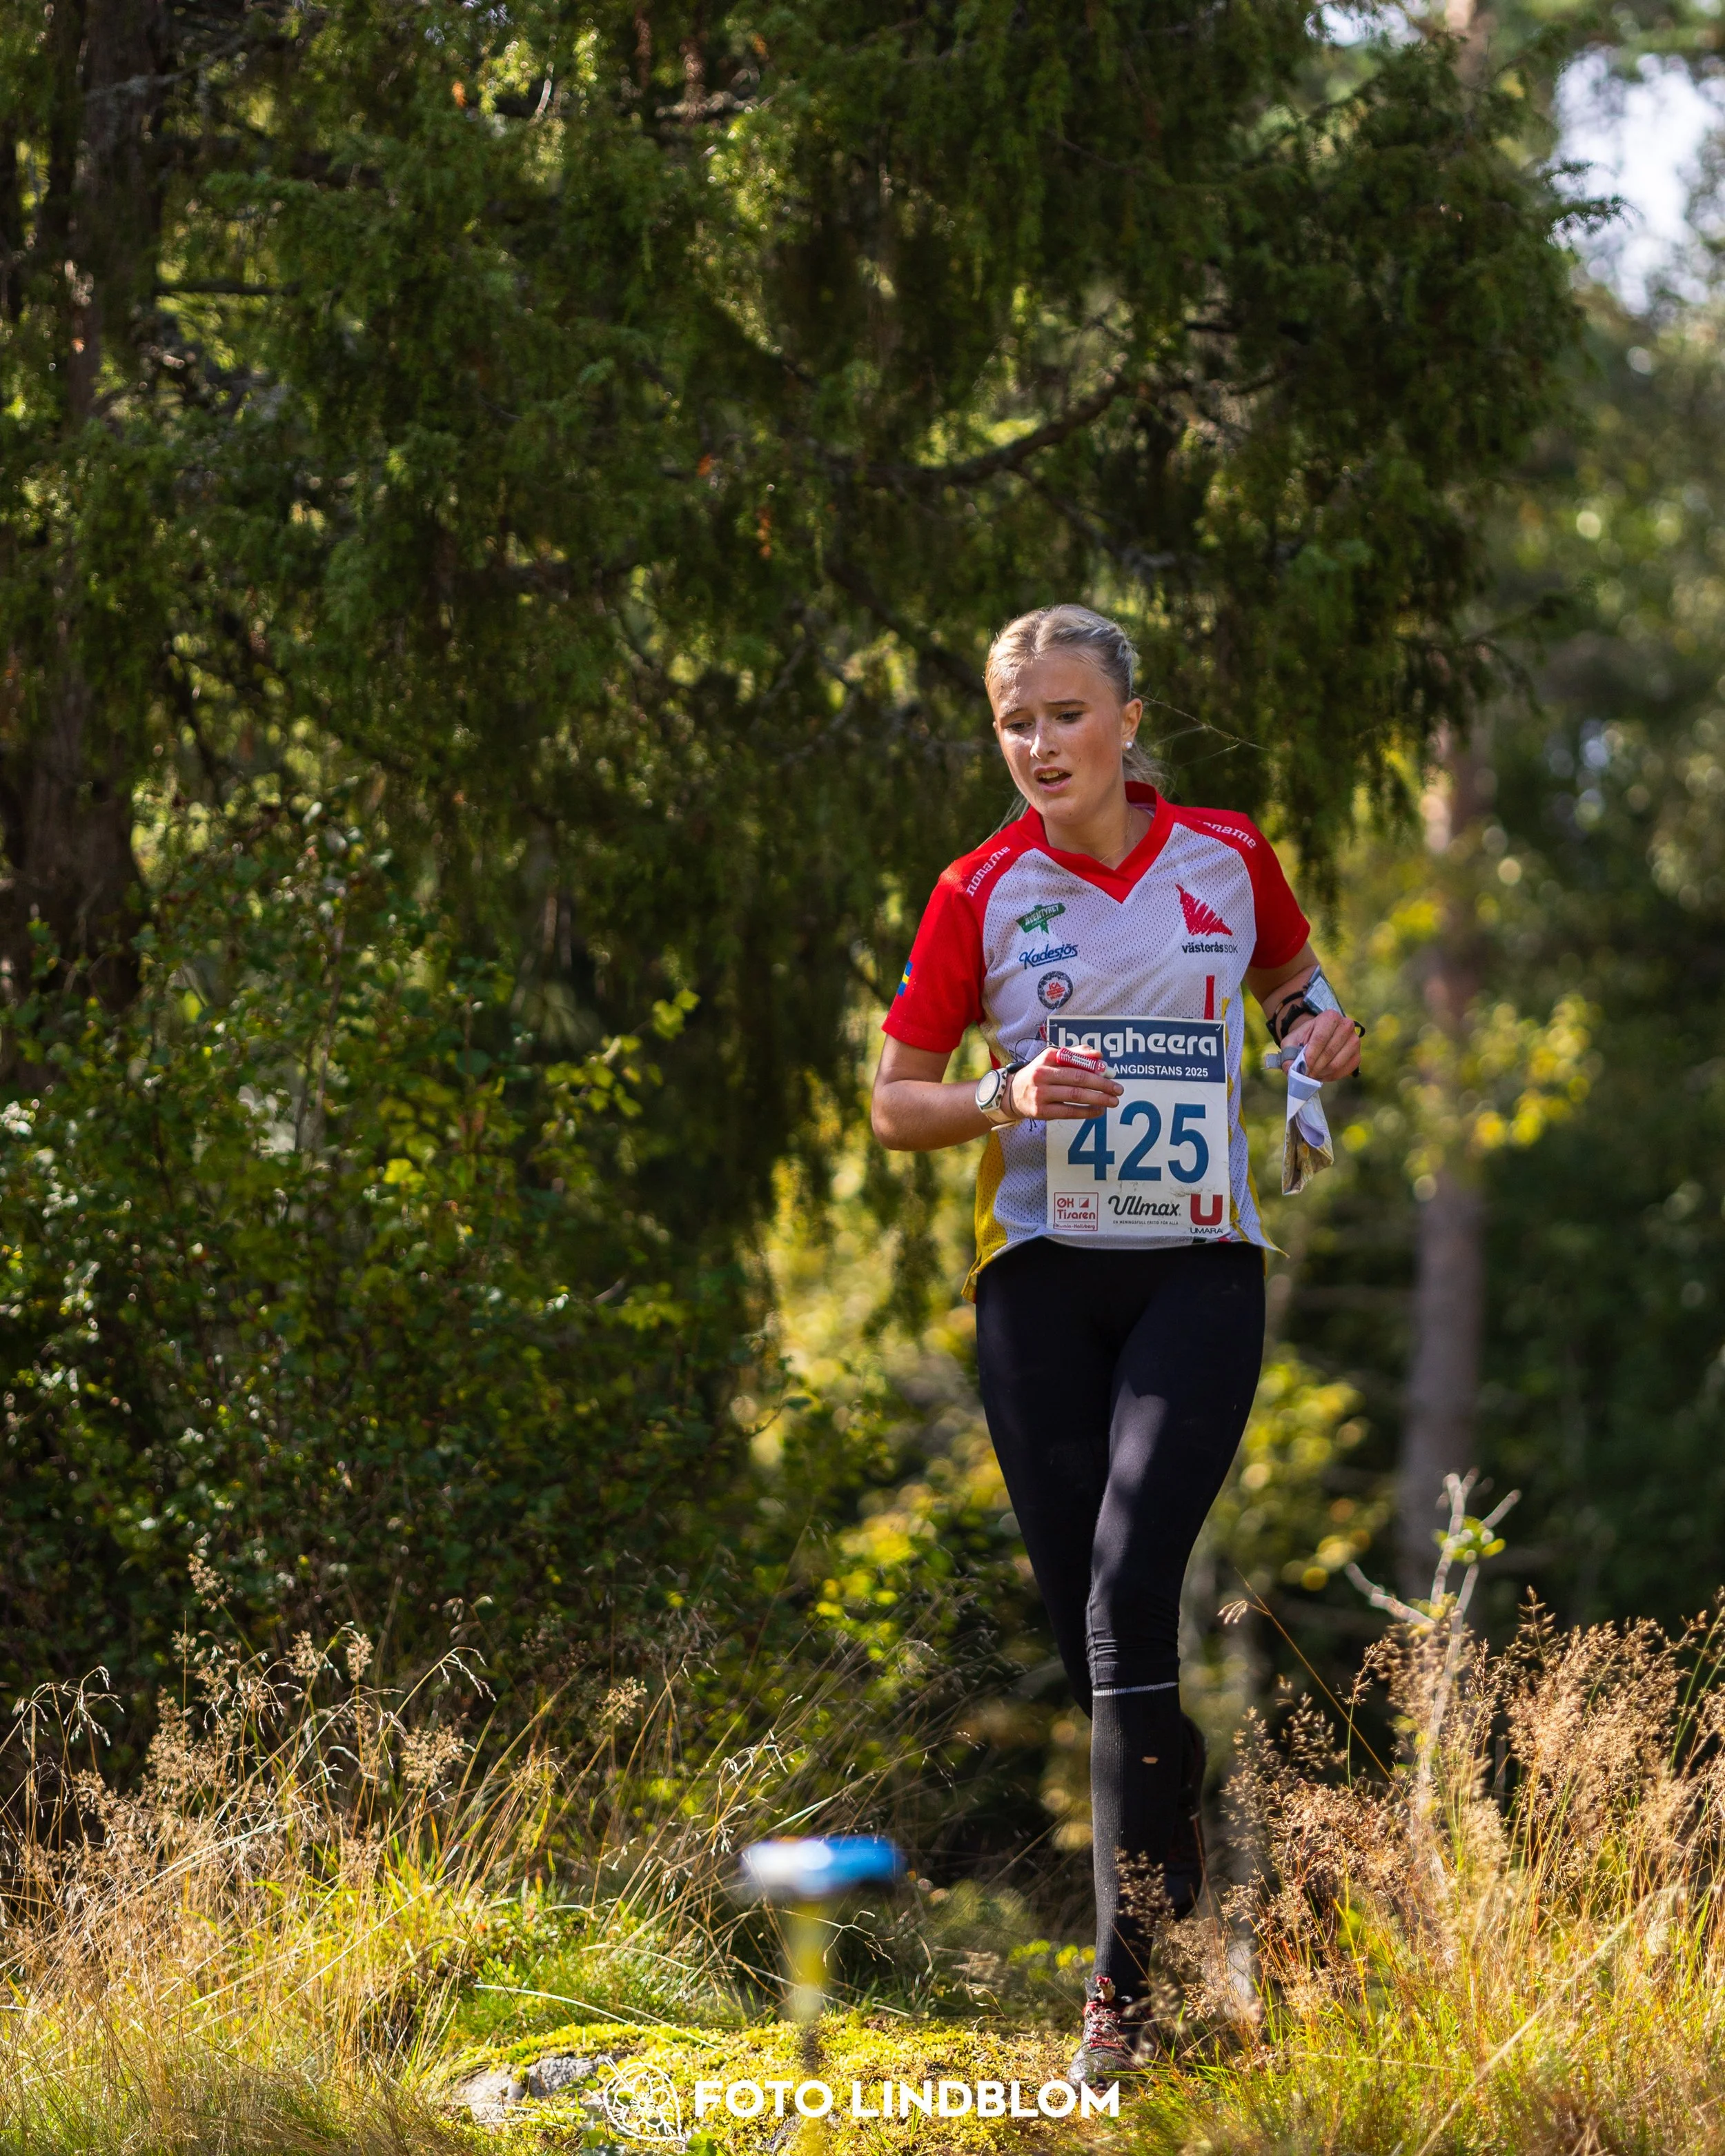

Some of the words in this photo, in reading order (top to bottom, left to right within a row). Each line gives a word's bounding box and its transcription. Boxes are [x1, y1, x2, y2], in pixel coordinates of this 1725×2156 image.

[966, 846, 1010, 897] noname
[1018, 943, 1078, 970] Kadesjös
[1049, 982, 1061, 990] ICA
[1113, 1063, 1183, 1076] ÅNGDISTANS
[1185, 1067, 1208, 1077] 2025
[1067, 1100, 1210, 1184] 425
[1057, 1209, 1096, 1219] Tisaren
